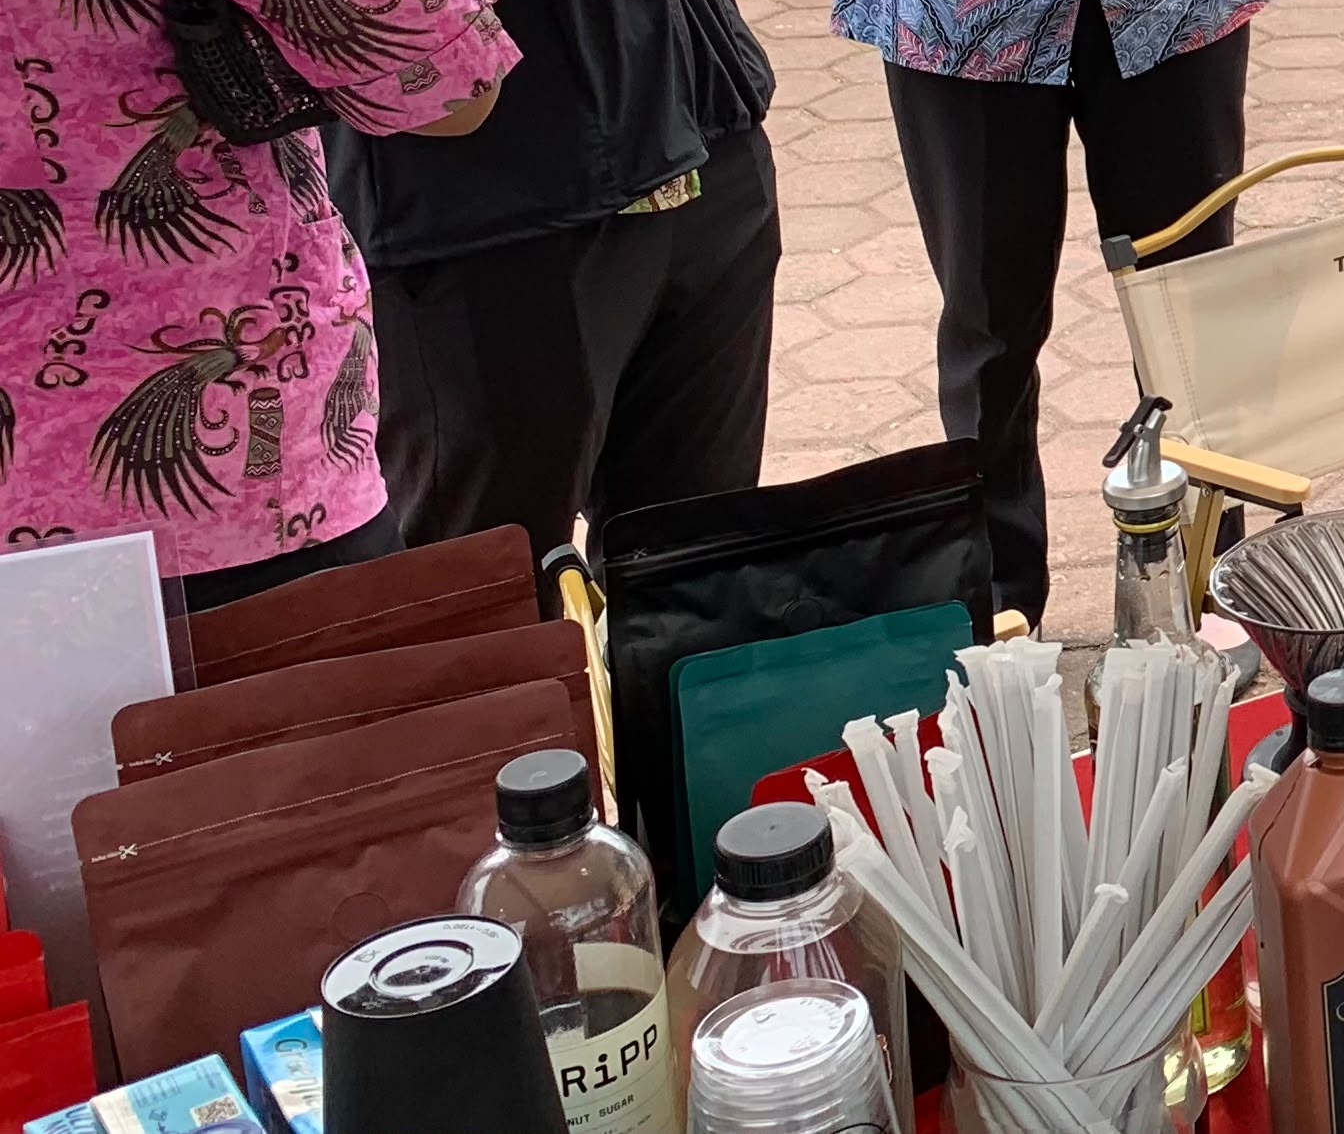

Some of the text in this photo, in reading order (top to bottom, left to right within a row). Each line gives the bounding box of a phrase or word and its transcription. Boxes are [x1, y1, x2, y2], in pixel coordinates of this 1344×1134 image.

[560, 1023, 658, 1098] RiPP
[566, 1113, 591, 1127] NUT
[598, 1094, 635, 1118] SUGAR
